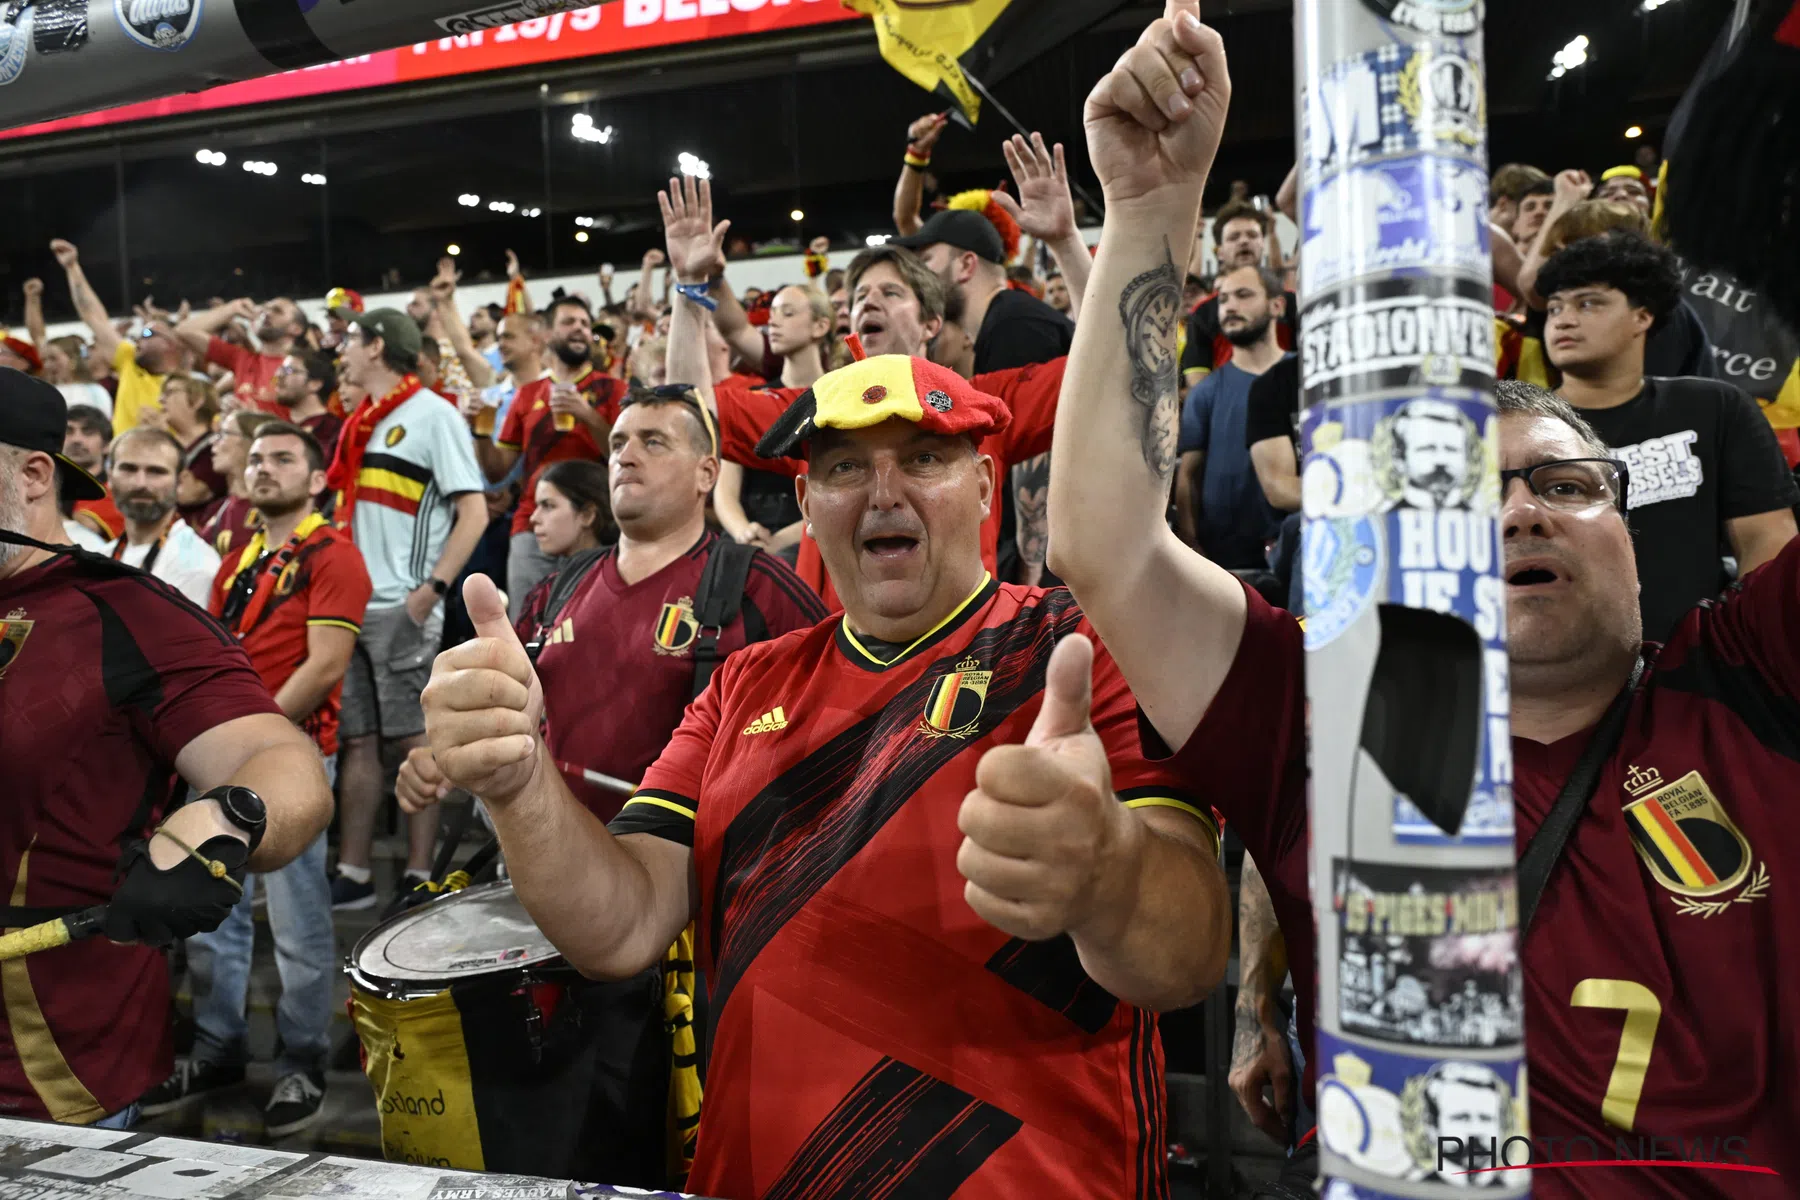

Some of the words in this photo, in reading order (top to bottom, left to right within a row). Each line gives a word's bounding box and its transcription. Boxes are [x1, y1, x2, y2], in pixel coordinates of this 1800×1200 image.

[1302, 306, 1493, 374] STADIONVE
[1711, 344, 1777, 380] rce
[743, 720, 788, 735] adidas
[1657, 786, 1688, 803] ROYAL
[1663, 789, 1703, 811] BELGIAN
[1668, 806, 1682, 819] FA
[1685, 797, 1708, 812] 1895
[1570, 978, 1662, 1132] 7
[380, 1089, 446, 1116] otland
[430, 1189, 489, 1200] ARMY
[491, 1186, 568, 1199] MAUVES
